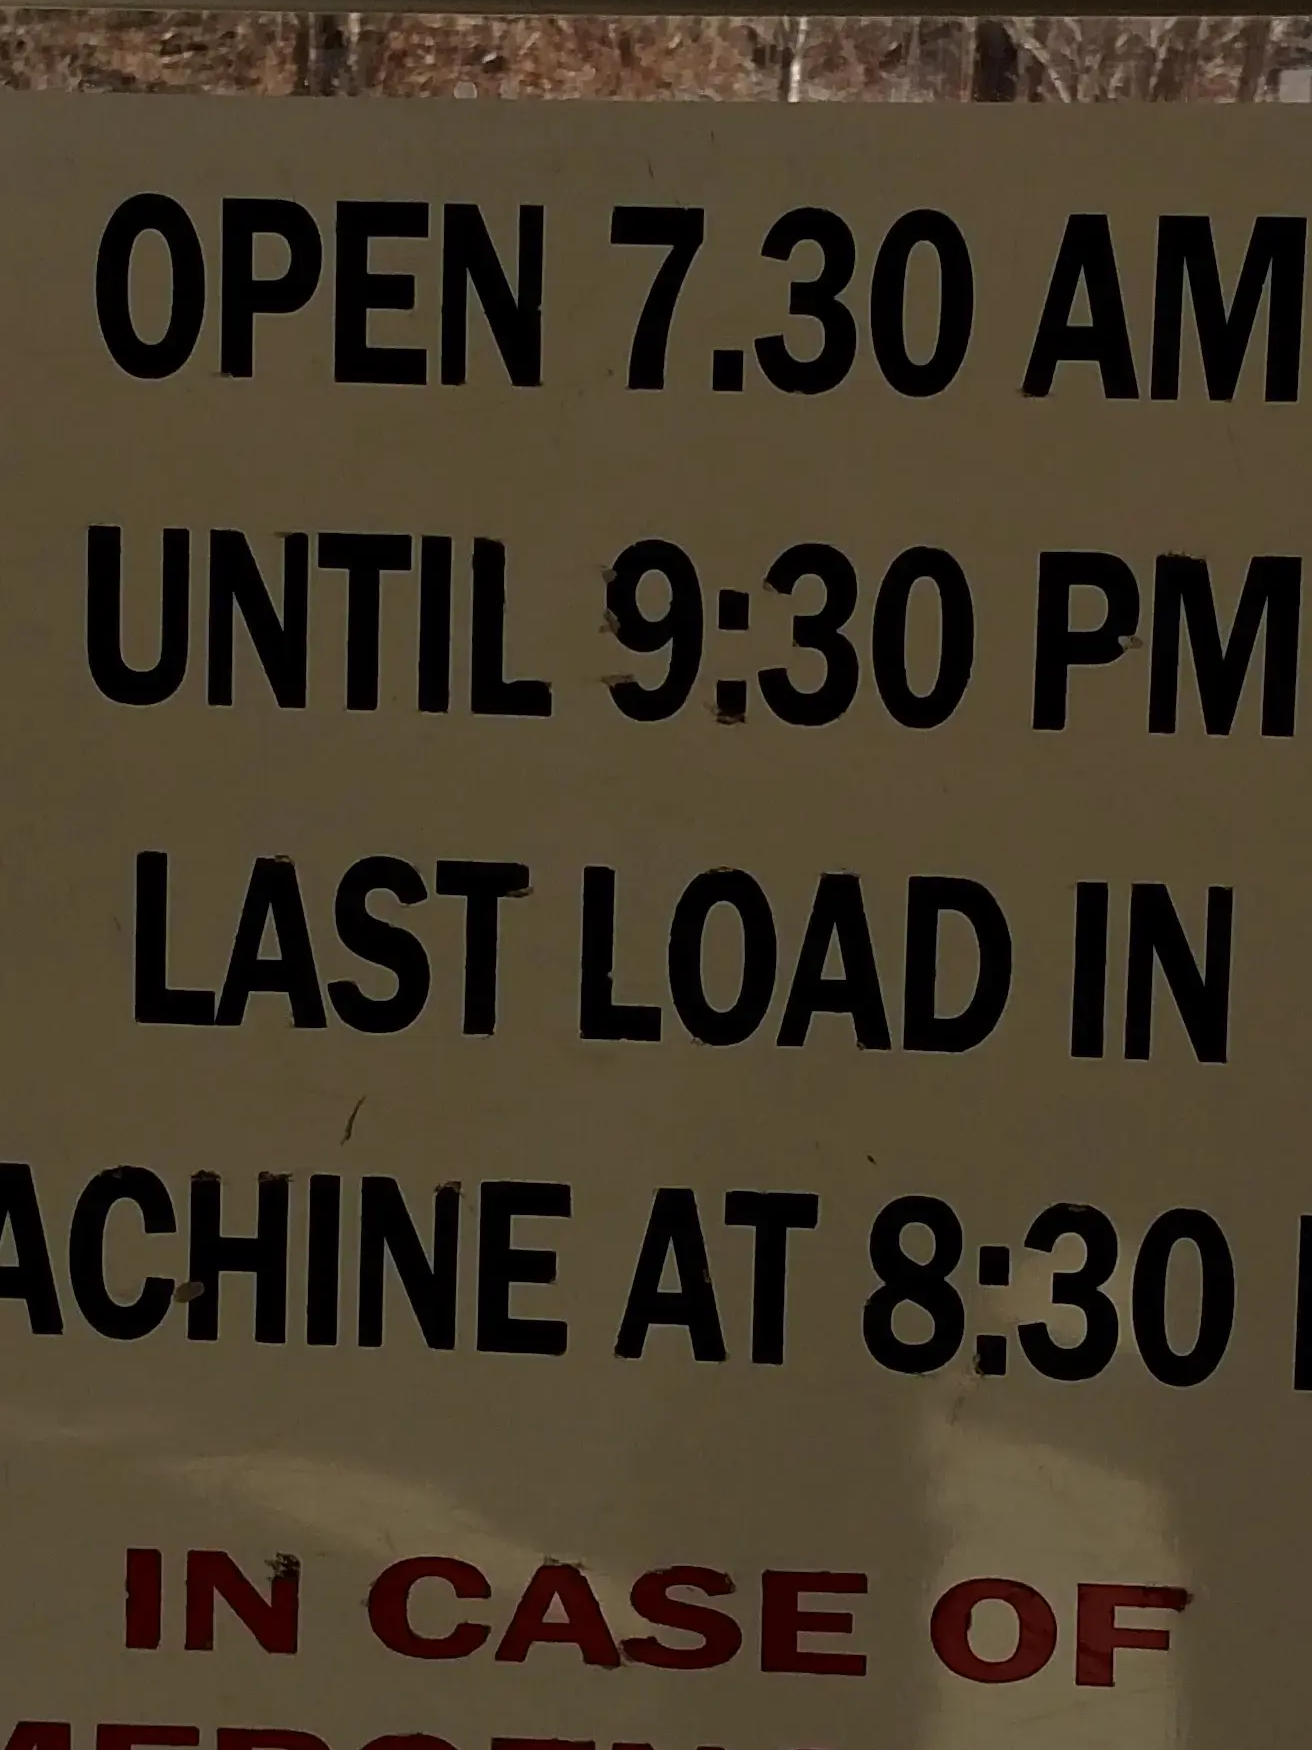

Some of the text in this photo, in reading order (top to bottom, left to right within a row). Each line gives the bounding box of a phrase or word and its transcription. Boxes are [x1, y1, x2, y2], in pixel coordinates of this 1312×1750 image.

[96, 193, 1307, 402] OPEN 7.30 AM
[88, 525, 1302, 737] UNTIL 9:30 PM
[135, 851, 1232, 1063] LAST LOAD IN
[615, 1188, 818, 1365] AT
[863, 1196, 1234, 1387] 8:30
[126, 1549, 1194, 1687] IN CASE OF
